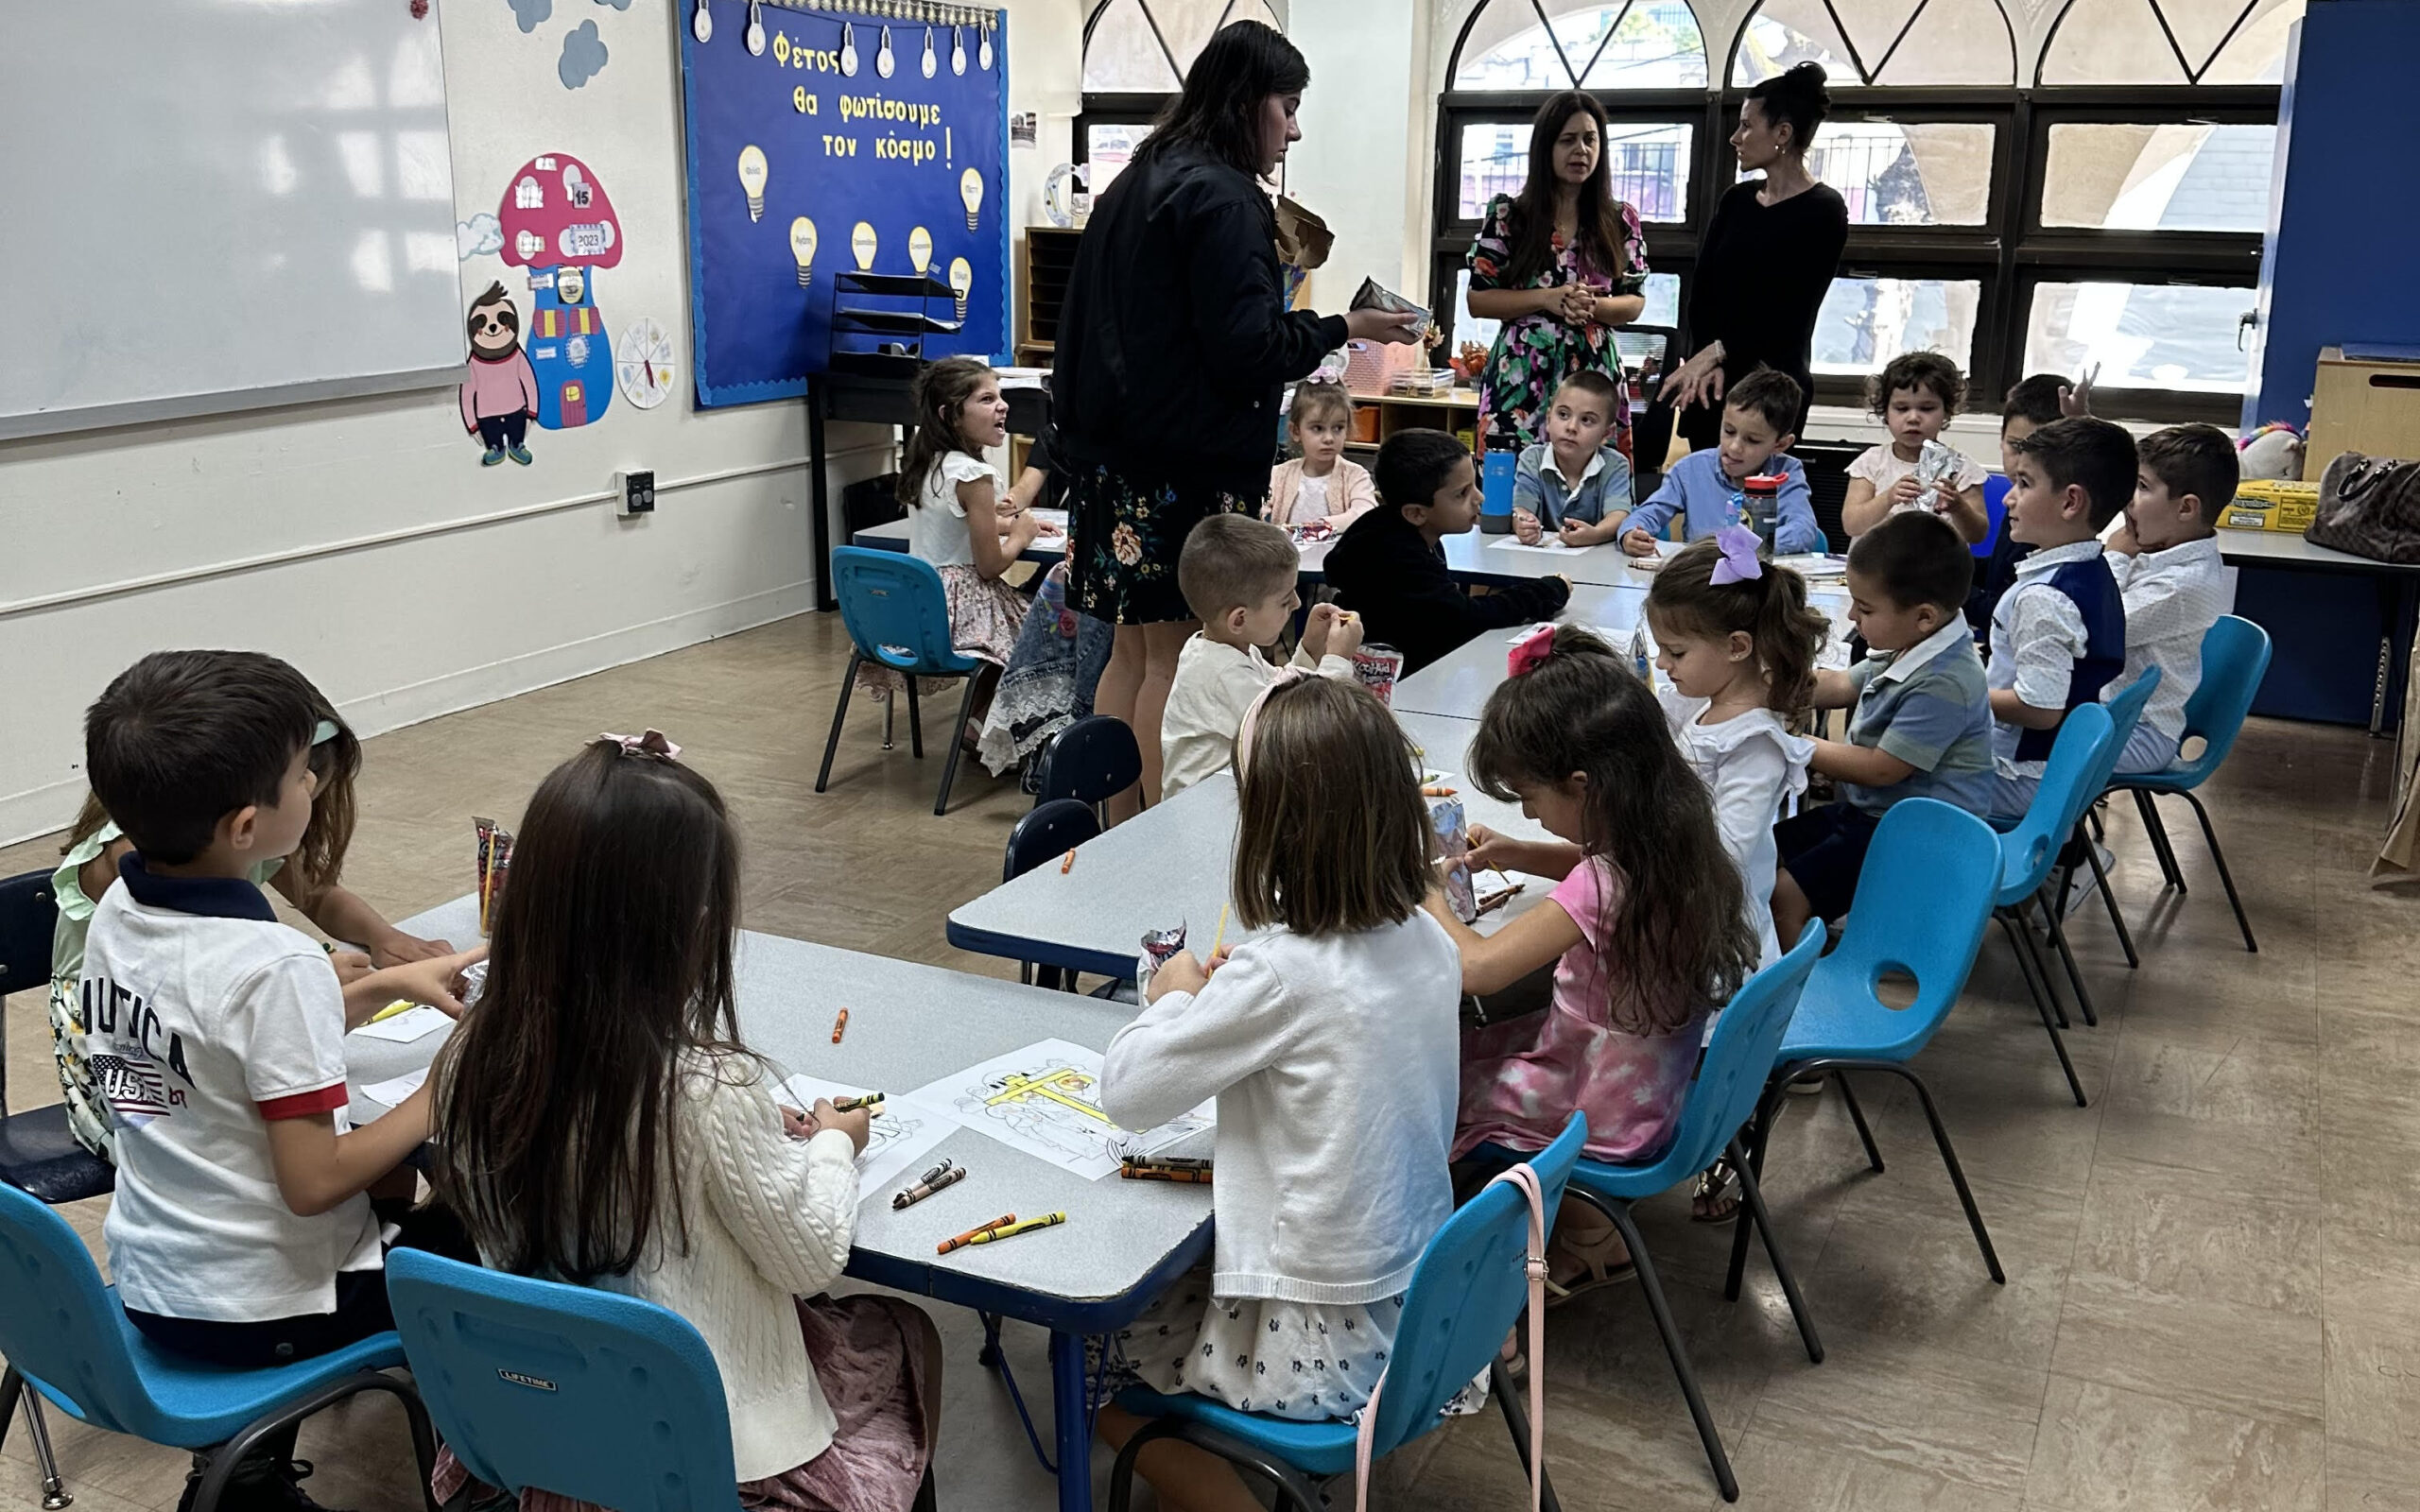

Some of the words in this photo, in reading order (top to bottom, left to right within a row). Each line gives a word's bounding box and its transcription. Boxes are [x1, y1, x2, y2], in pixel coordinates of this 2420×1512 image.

[773, 31, 839, 75] Φέτος
[839, 93, 941, 130] φωτίσουμε
[822, 134, 857, 157] τον
[875, 130, 936, 165] κόσμο
[576, 190, 589, 205] 15
[579, 234, 599, 247] 2023
[504, 1370, 550, 1388] LIFETIME
